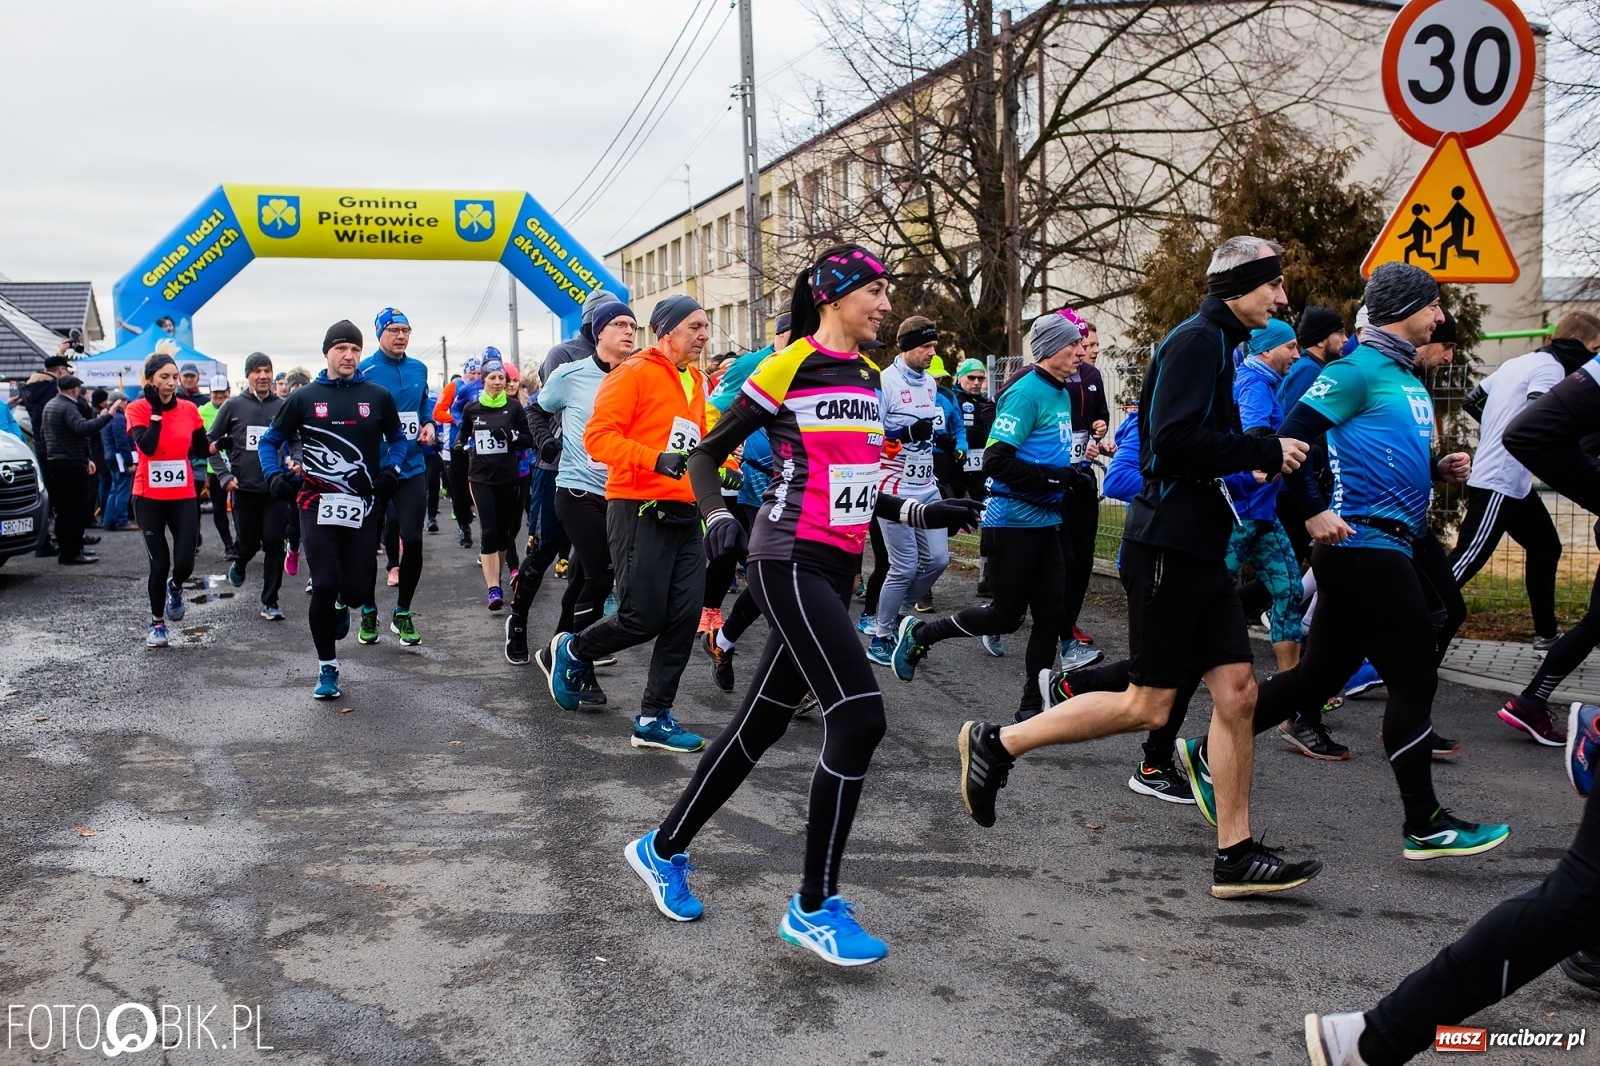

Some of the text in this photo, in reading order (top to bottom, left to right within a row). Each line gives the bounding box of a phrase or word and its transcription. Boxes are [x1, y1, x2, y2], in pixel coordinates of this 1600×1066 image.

[1407, 23, 1511, 106] 30
[338, 196, 418, 209] Gmina
[318, 211, 439, 227] Pietrowice
[334, 229, 424, 244] Wielkie
[142, 208, 226, 287] Gmina ludzi
[525, 217, 604, 291] Gmina ludzi
[162, 226, 240, 301] aktywnych
[513, 235, 587, 305] aktywnych
[477, 438, 506, 449] 135
[151, 470, 186, 482] 394
[906, 464, 932, 478] 338
[834, 484, 877, 513] 446
[321, 504, 362, 522] 352
[3, 521, 15, 534] SRC
